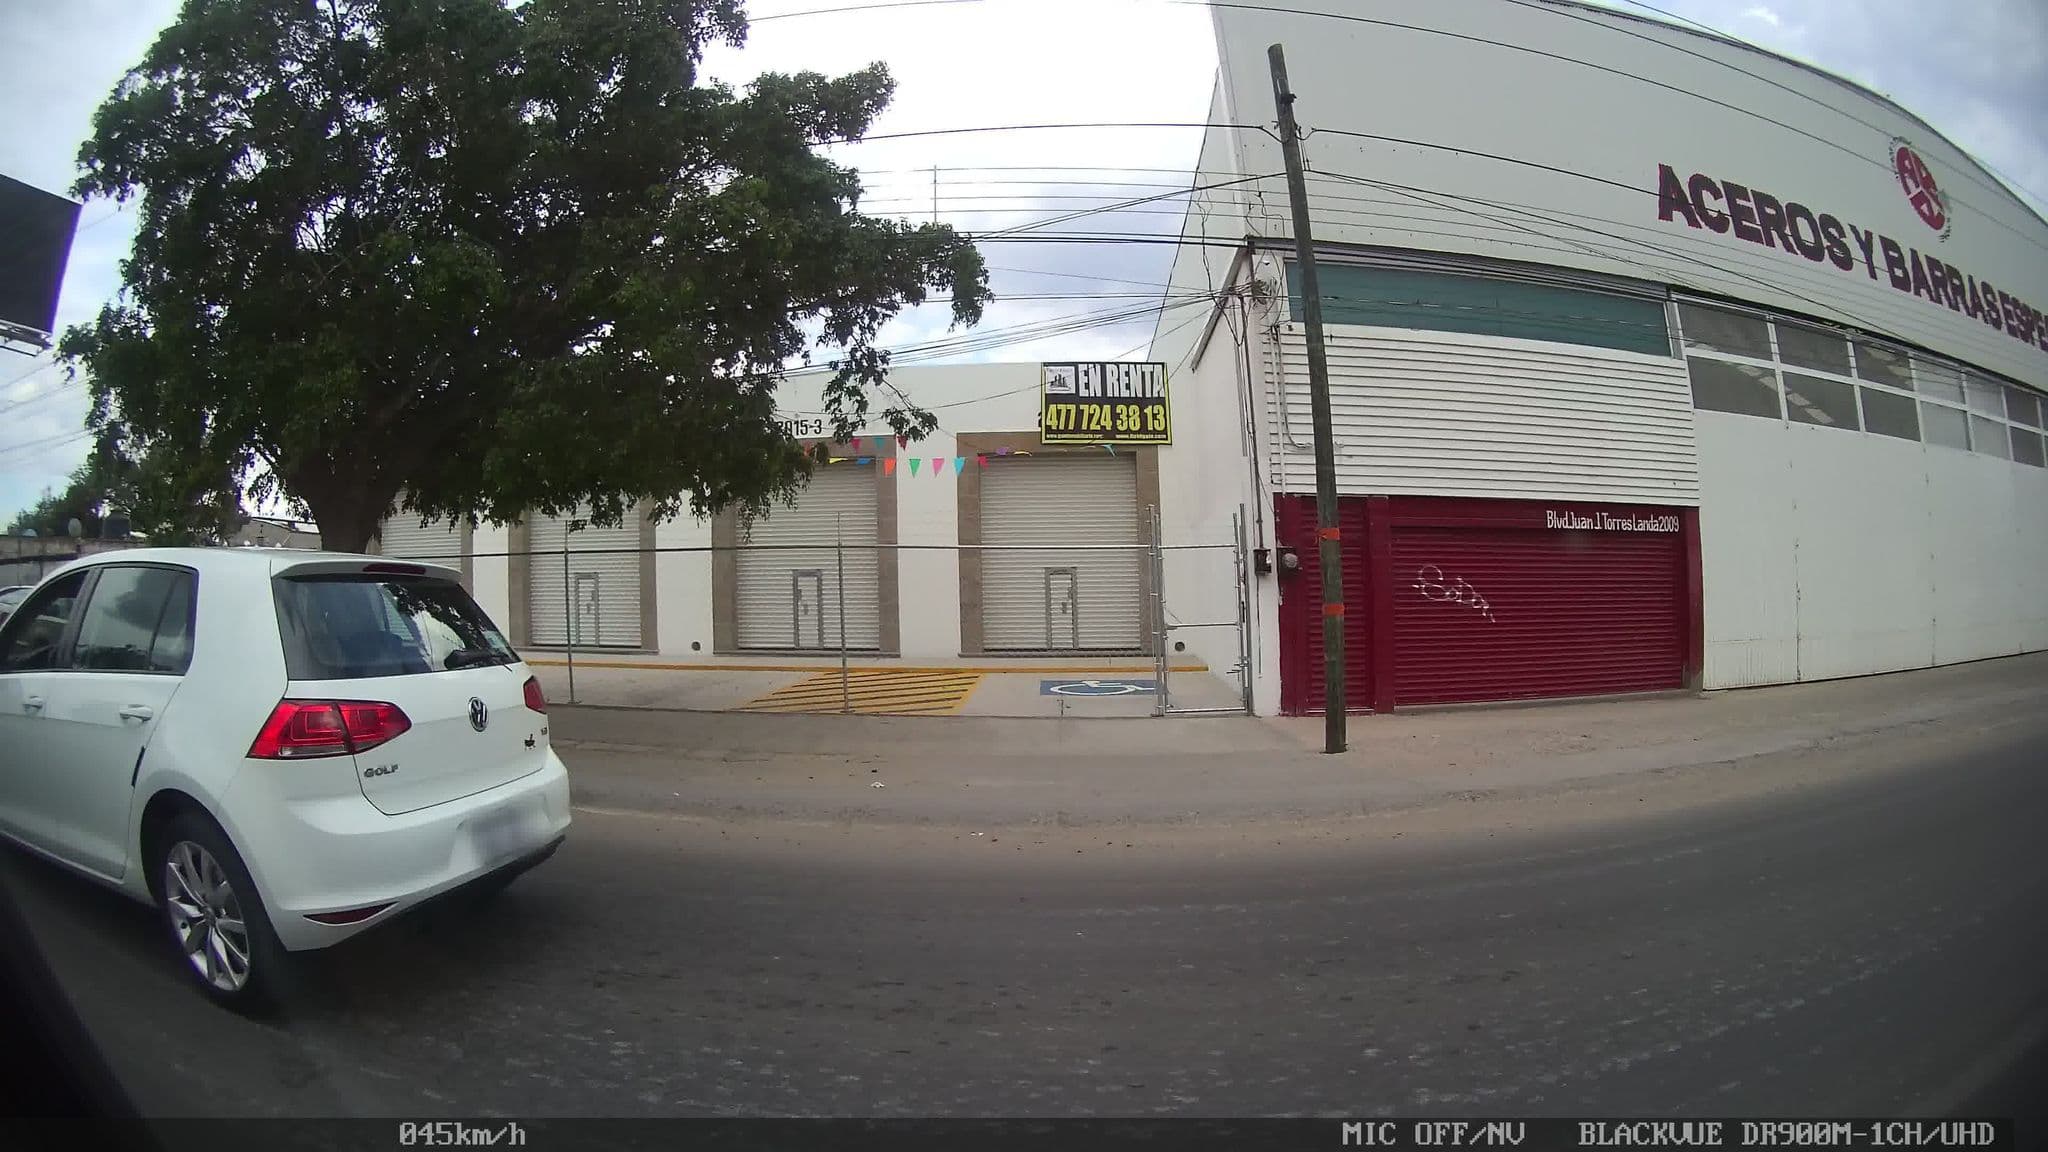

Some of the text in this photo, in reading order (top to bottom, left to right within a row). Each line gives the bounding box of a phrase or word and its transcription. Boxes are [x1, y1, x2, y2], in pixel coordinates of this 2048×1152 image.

[1658, 163, 1854, 272] ACEROS
[1848, 223, 1878, 280] Y
[1879, 234, 2002, 331] BARRAS
[1077, 363, 1165, 398] EN RENTA
[1046, 404, 1077, 430] 477
[1079, 404, 1113, 431] 724
[1115, 404, 1141, 431] 38
[1144, 404, 1166, 431] 13
[1601, 513, 1633, 532] Torres
[1633, 514, 1659, 532] Landa
[1659, 516, 1680, 532] 2009
[363, 763, 399, 778] GOLF
